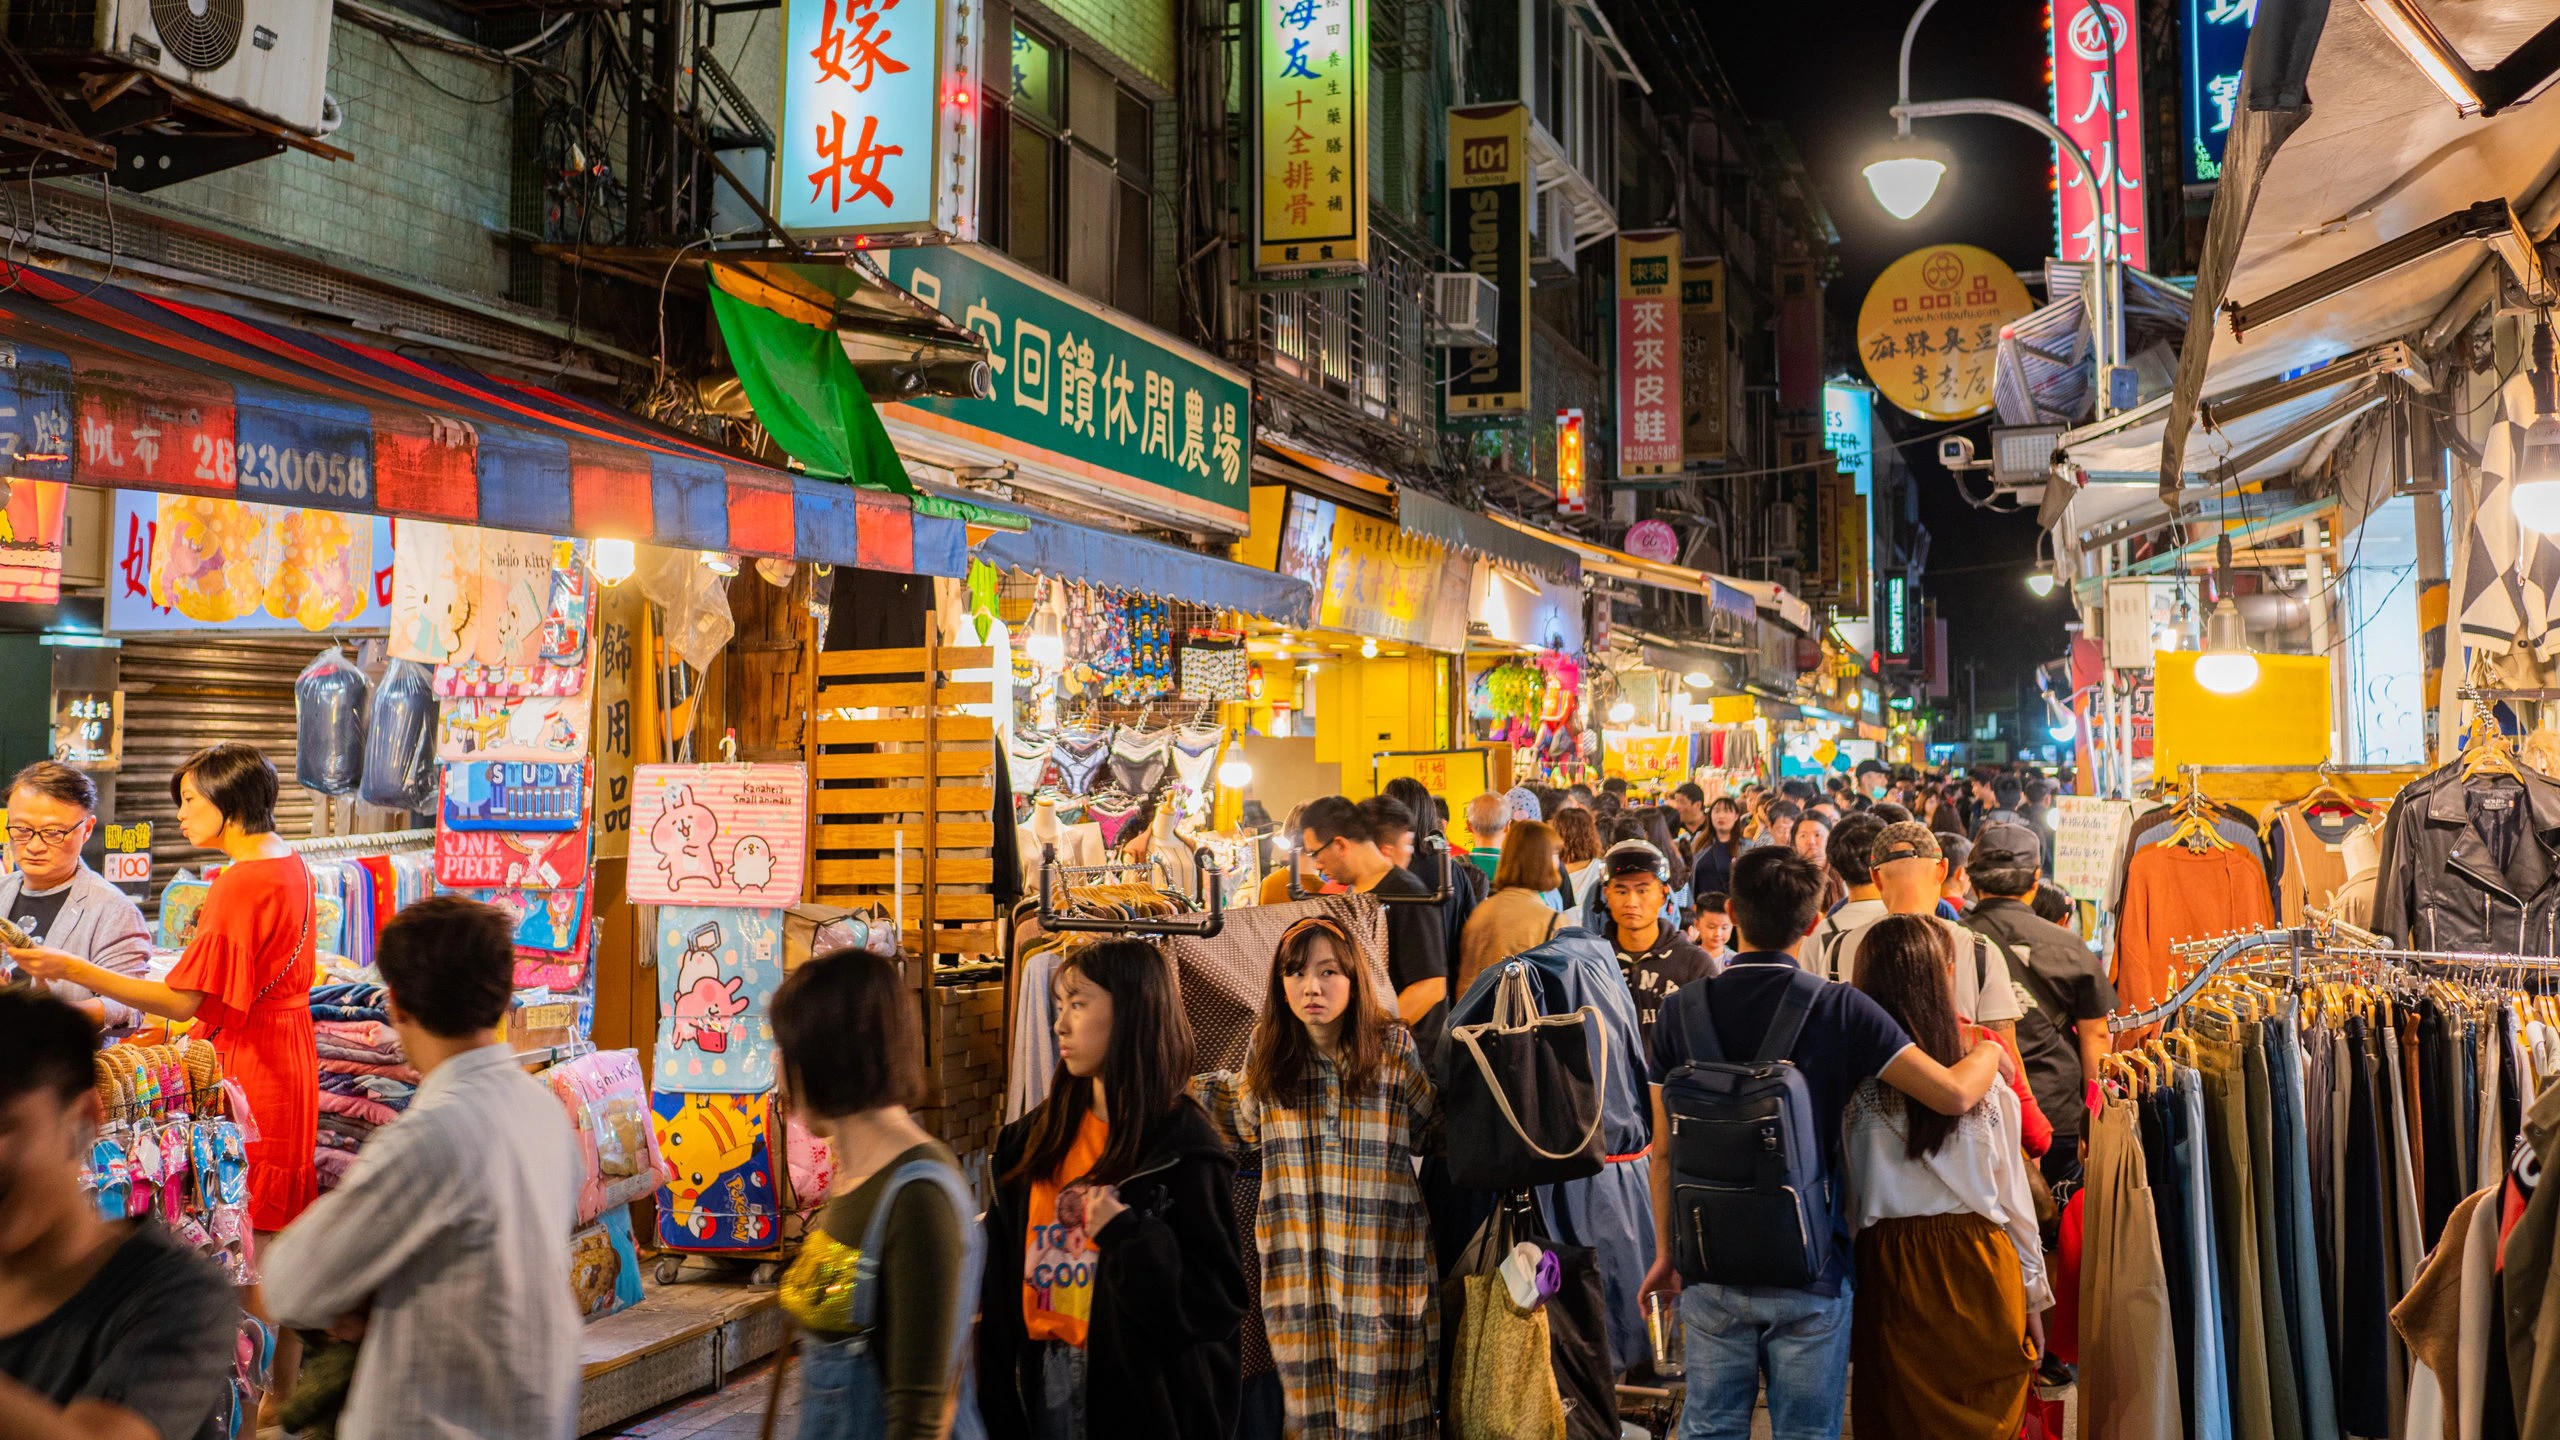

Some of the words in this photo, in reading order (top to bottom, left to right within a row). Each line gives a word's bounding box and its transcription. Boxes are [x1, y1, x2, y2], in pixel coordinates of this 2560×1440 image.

[1465, 146, 1506, 169] 101
[1465, 174, 1506, 185] Clothing
[911, 267, 1242, 486] 安回饋休閒農場
[1633, 301, 1666, 443] 來來皮鞋
[192, 434, 368, 499] 28230058
[497, 552, 519, 567] Hello
[524, 554, 551, 571] Kitty
[601, 588, 632, 833] 飾用品
[492, 763, 574, 784] STUDY
[743, 781, 784, 794] Kanahei's
[733, 794, 757, 804] Small
[758, 796, 792, 805] animals
[442, 832, 502, 856] ONE
[119, 857, 150, 879] 100
[442, 857, 502, 880] PIECE
